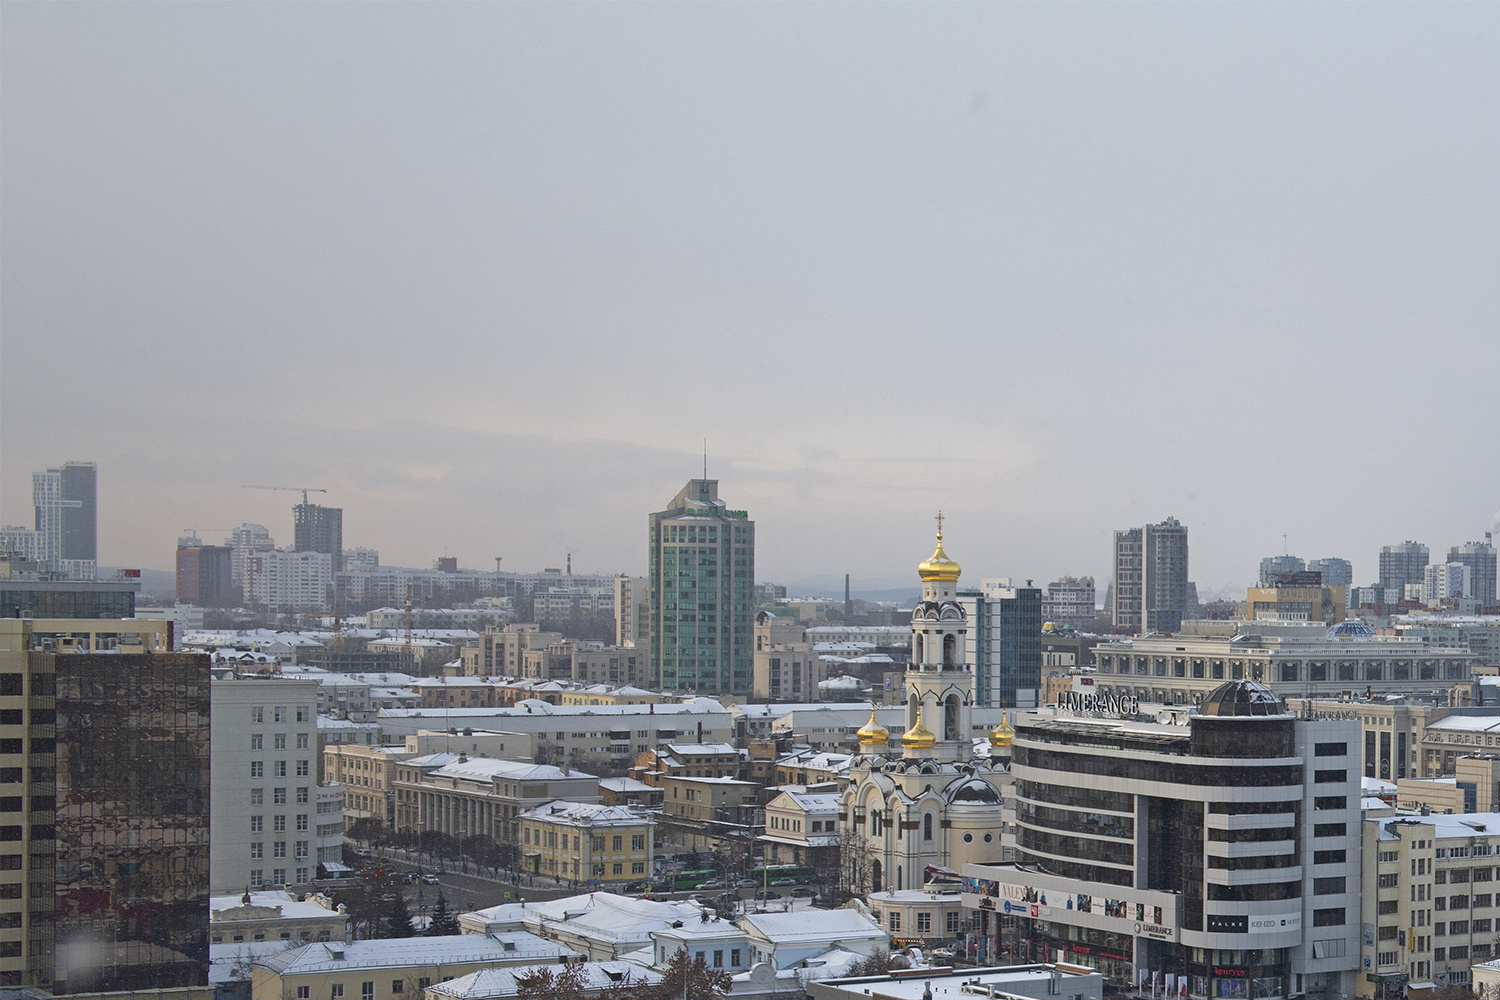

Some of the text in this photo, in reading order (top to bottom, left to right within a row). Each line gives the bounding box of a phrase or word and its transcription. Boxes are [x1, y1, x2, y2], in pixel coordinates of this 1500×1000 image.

[1279, 590, 1319, 600] SAMSUNG
[1056, 692, 1140, 715] LIMERANCE
[1251, 919, 1275, 928] KENZO
